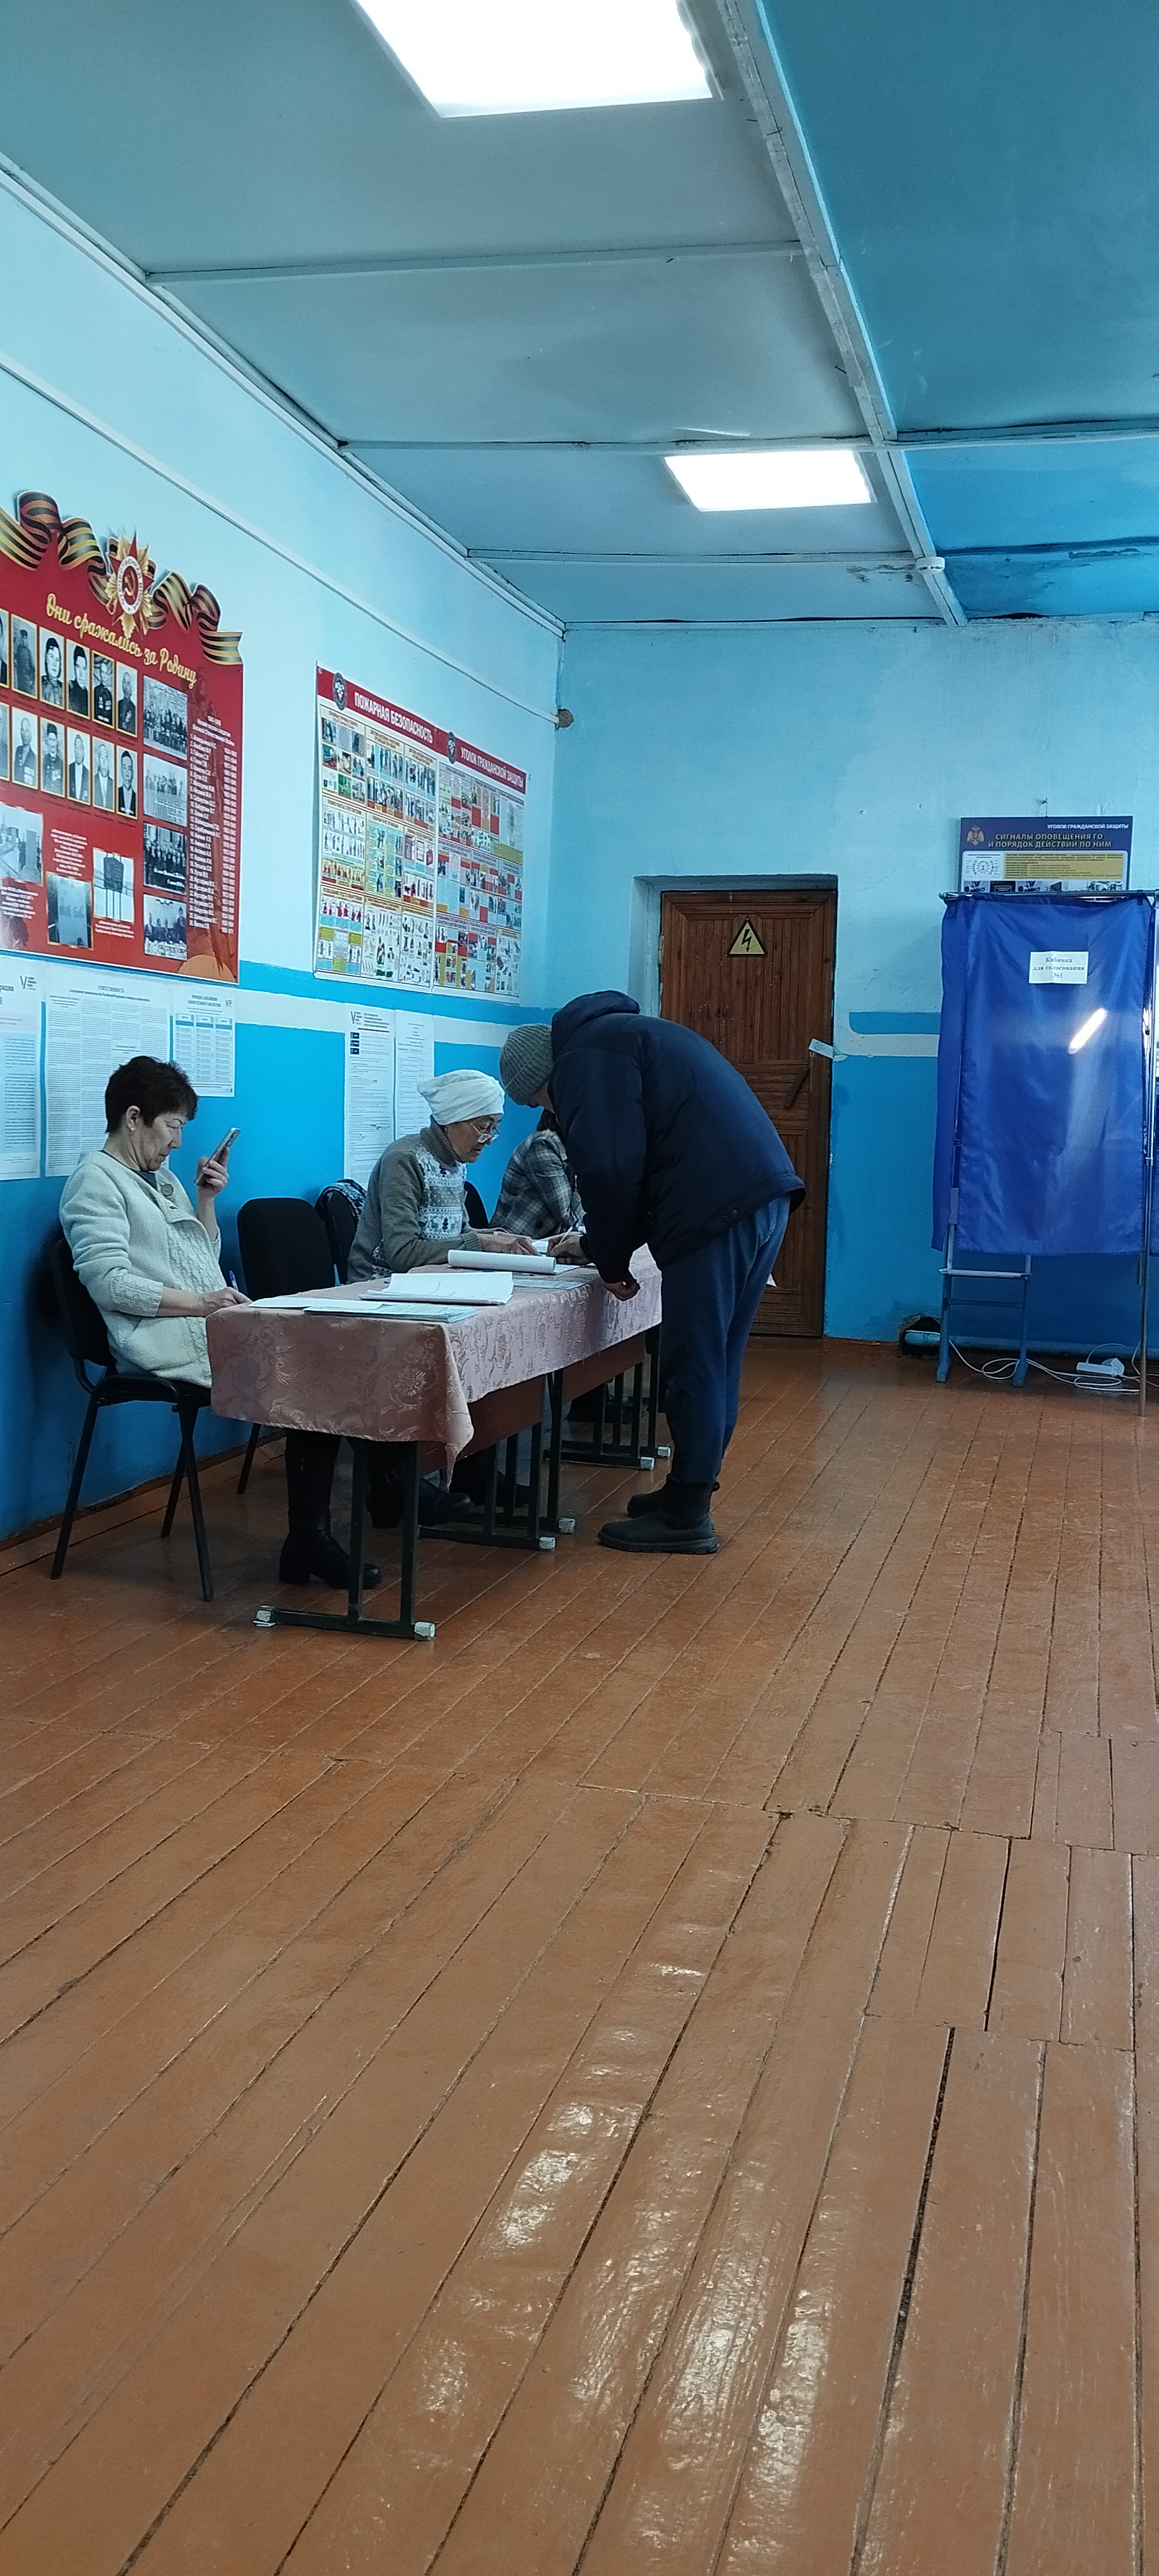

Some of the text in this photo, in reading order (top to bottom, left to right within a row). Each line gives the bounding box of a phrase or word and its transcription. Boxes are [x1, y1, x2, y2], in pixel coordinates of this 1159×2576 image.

[46, 593, 197, 689] Они сражались за Родину
[354, 691, 389, 722] ПОЖАРНАЯ
[390, 710, 433, 744] БЕЗОПАСНОСТЬ
[460, 746, 477, 766] УГОЛОК
[1035, 840, 1078, 849] ДЕЙСТВИЙ
